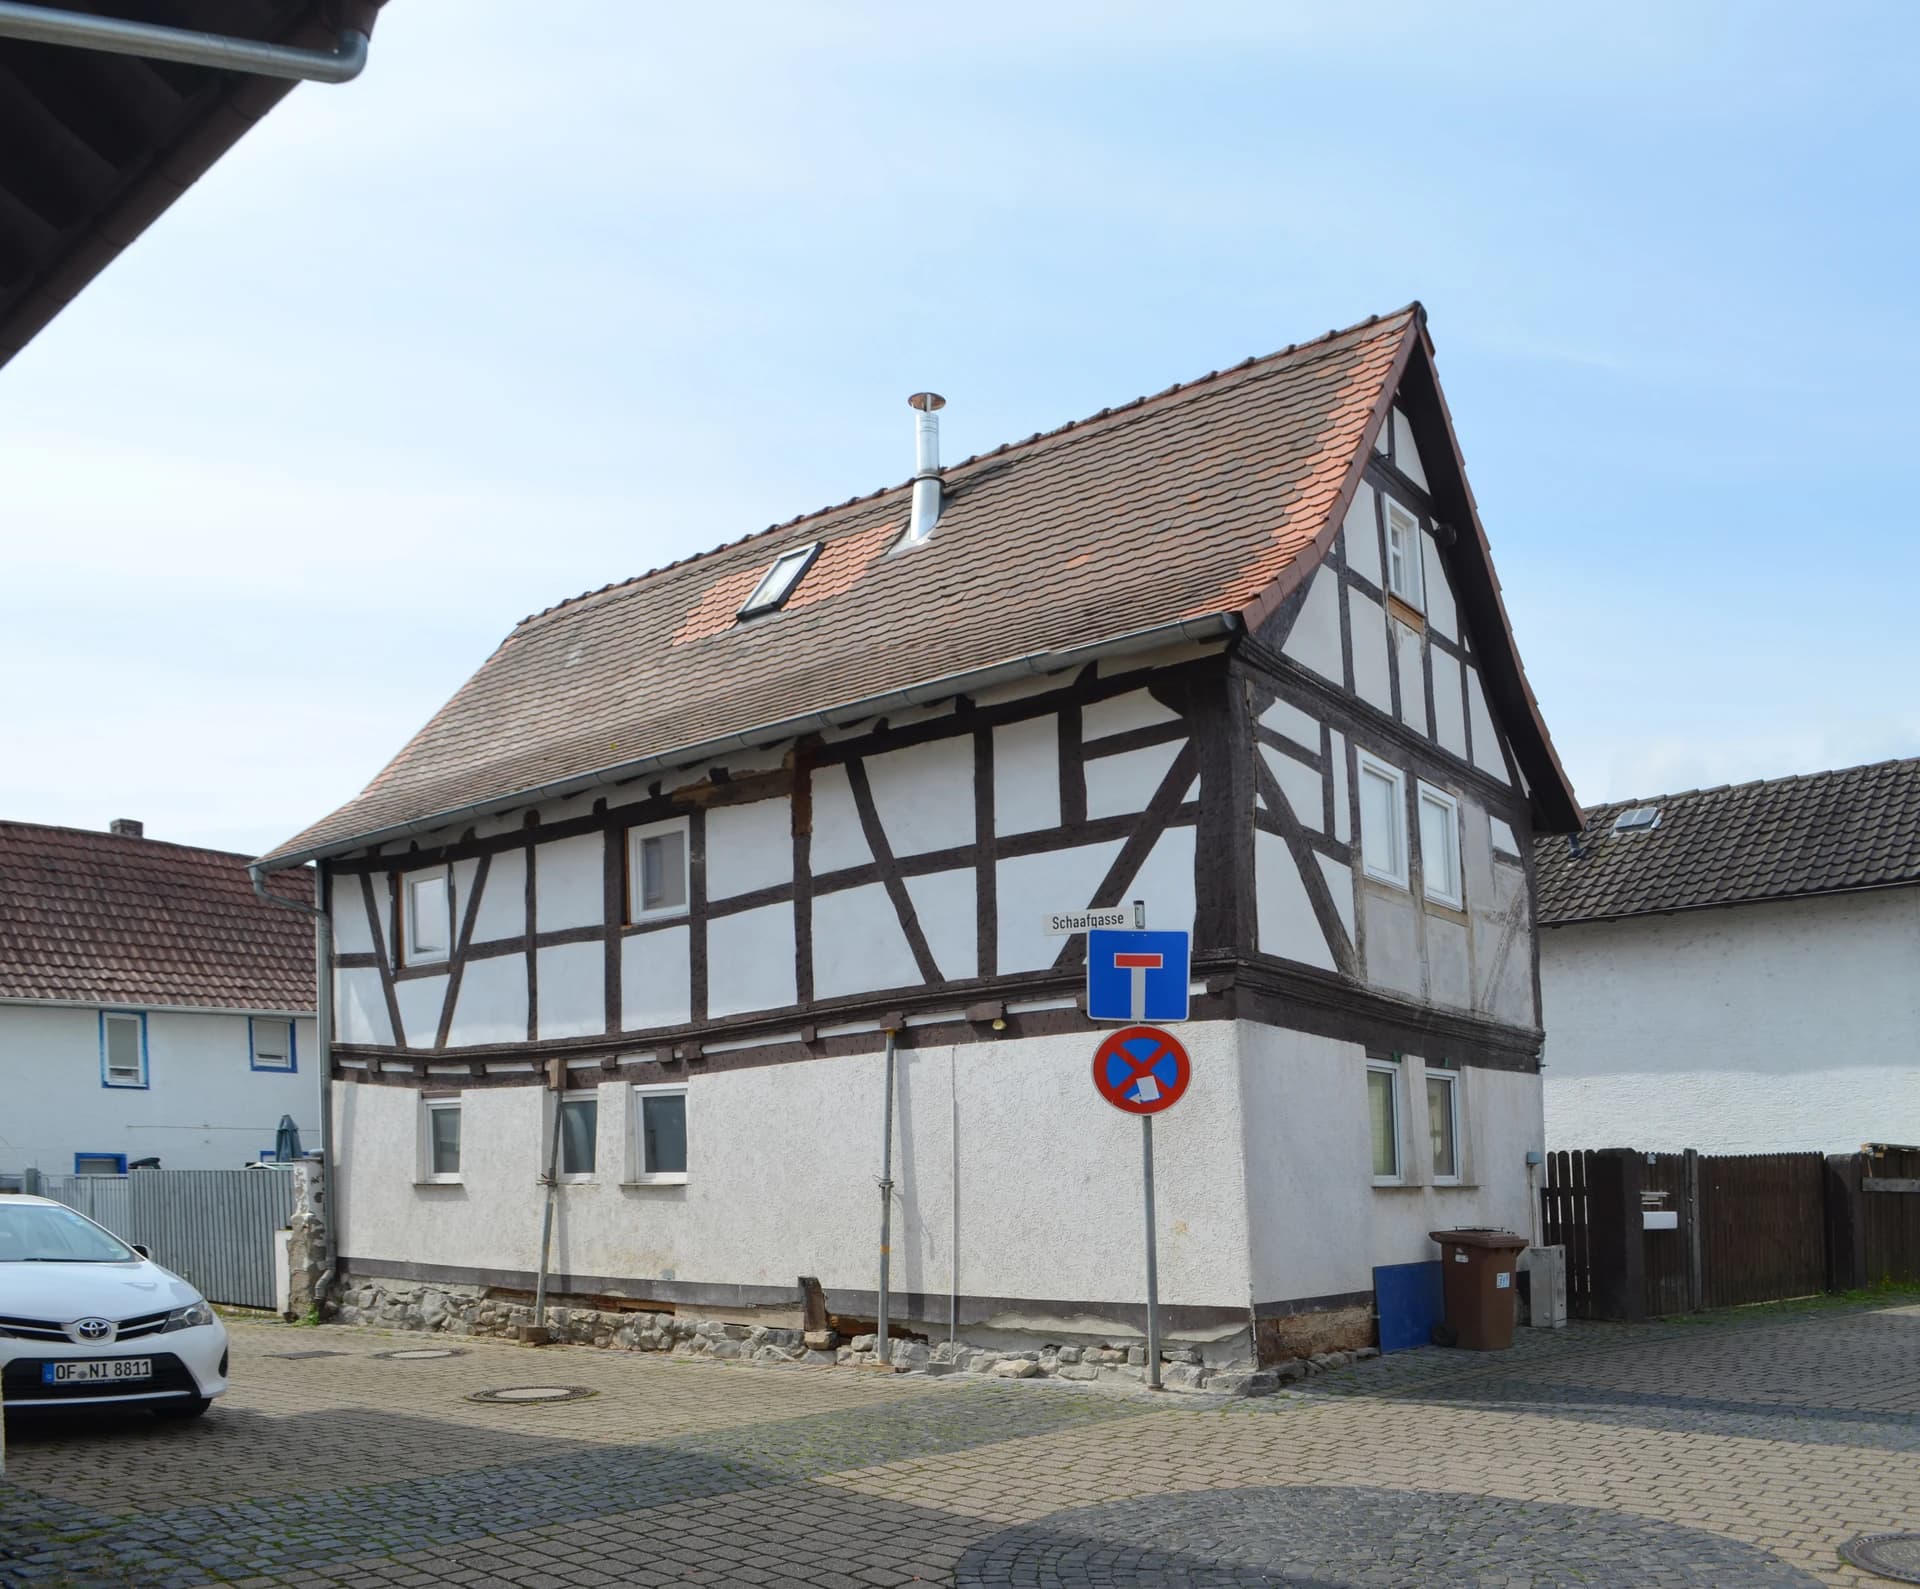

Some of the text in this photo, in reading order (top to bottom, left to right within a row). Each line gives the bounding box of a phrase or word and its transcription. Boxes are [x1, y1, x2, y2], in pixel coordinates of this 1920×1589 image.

[1052, 913, 1124, 929] Schaafgasse
[55, 1361, 150, 1380] OF NI 8811
